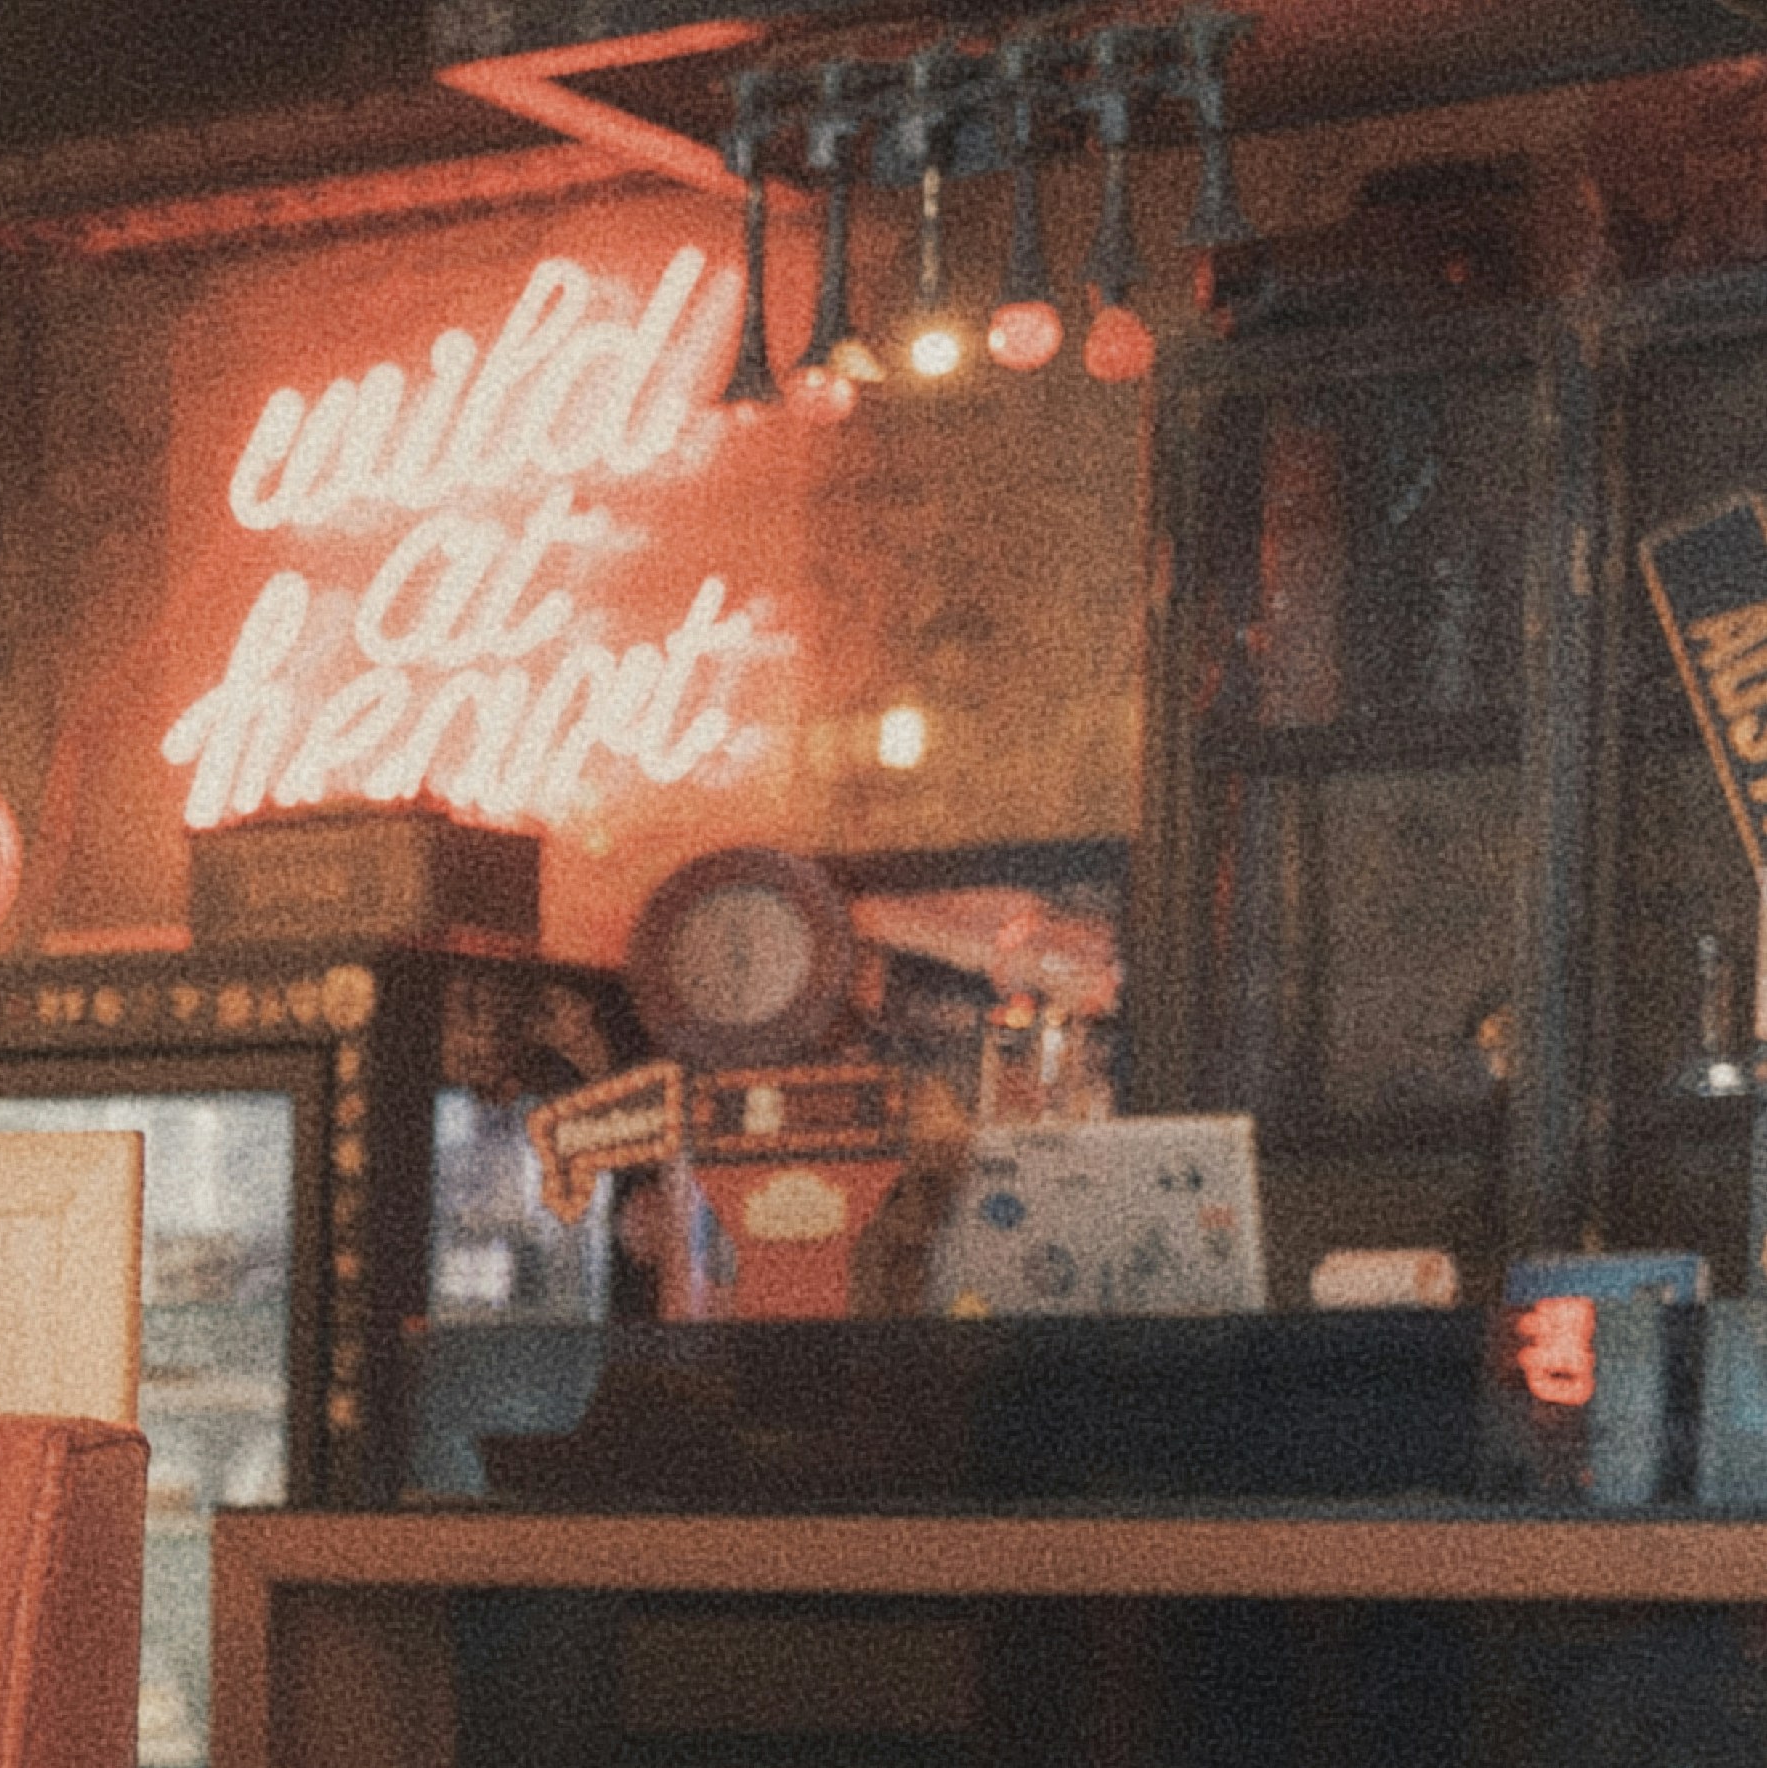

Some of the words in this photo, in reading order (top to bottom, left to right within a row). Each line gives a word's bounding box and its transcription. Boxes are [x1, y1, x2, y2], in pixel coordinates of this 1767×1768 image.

[231, 247, 707, 529] wild
[162, 572, 751, 828] heart
[357, 486, 610, 666] at
